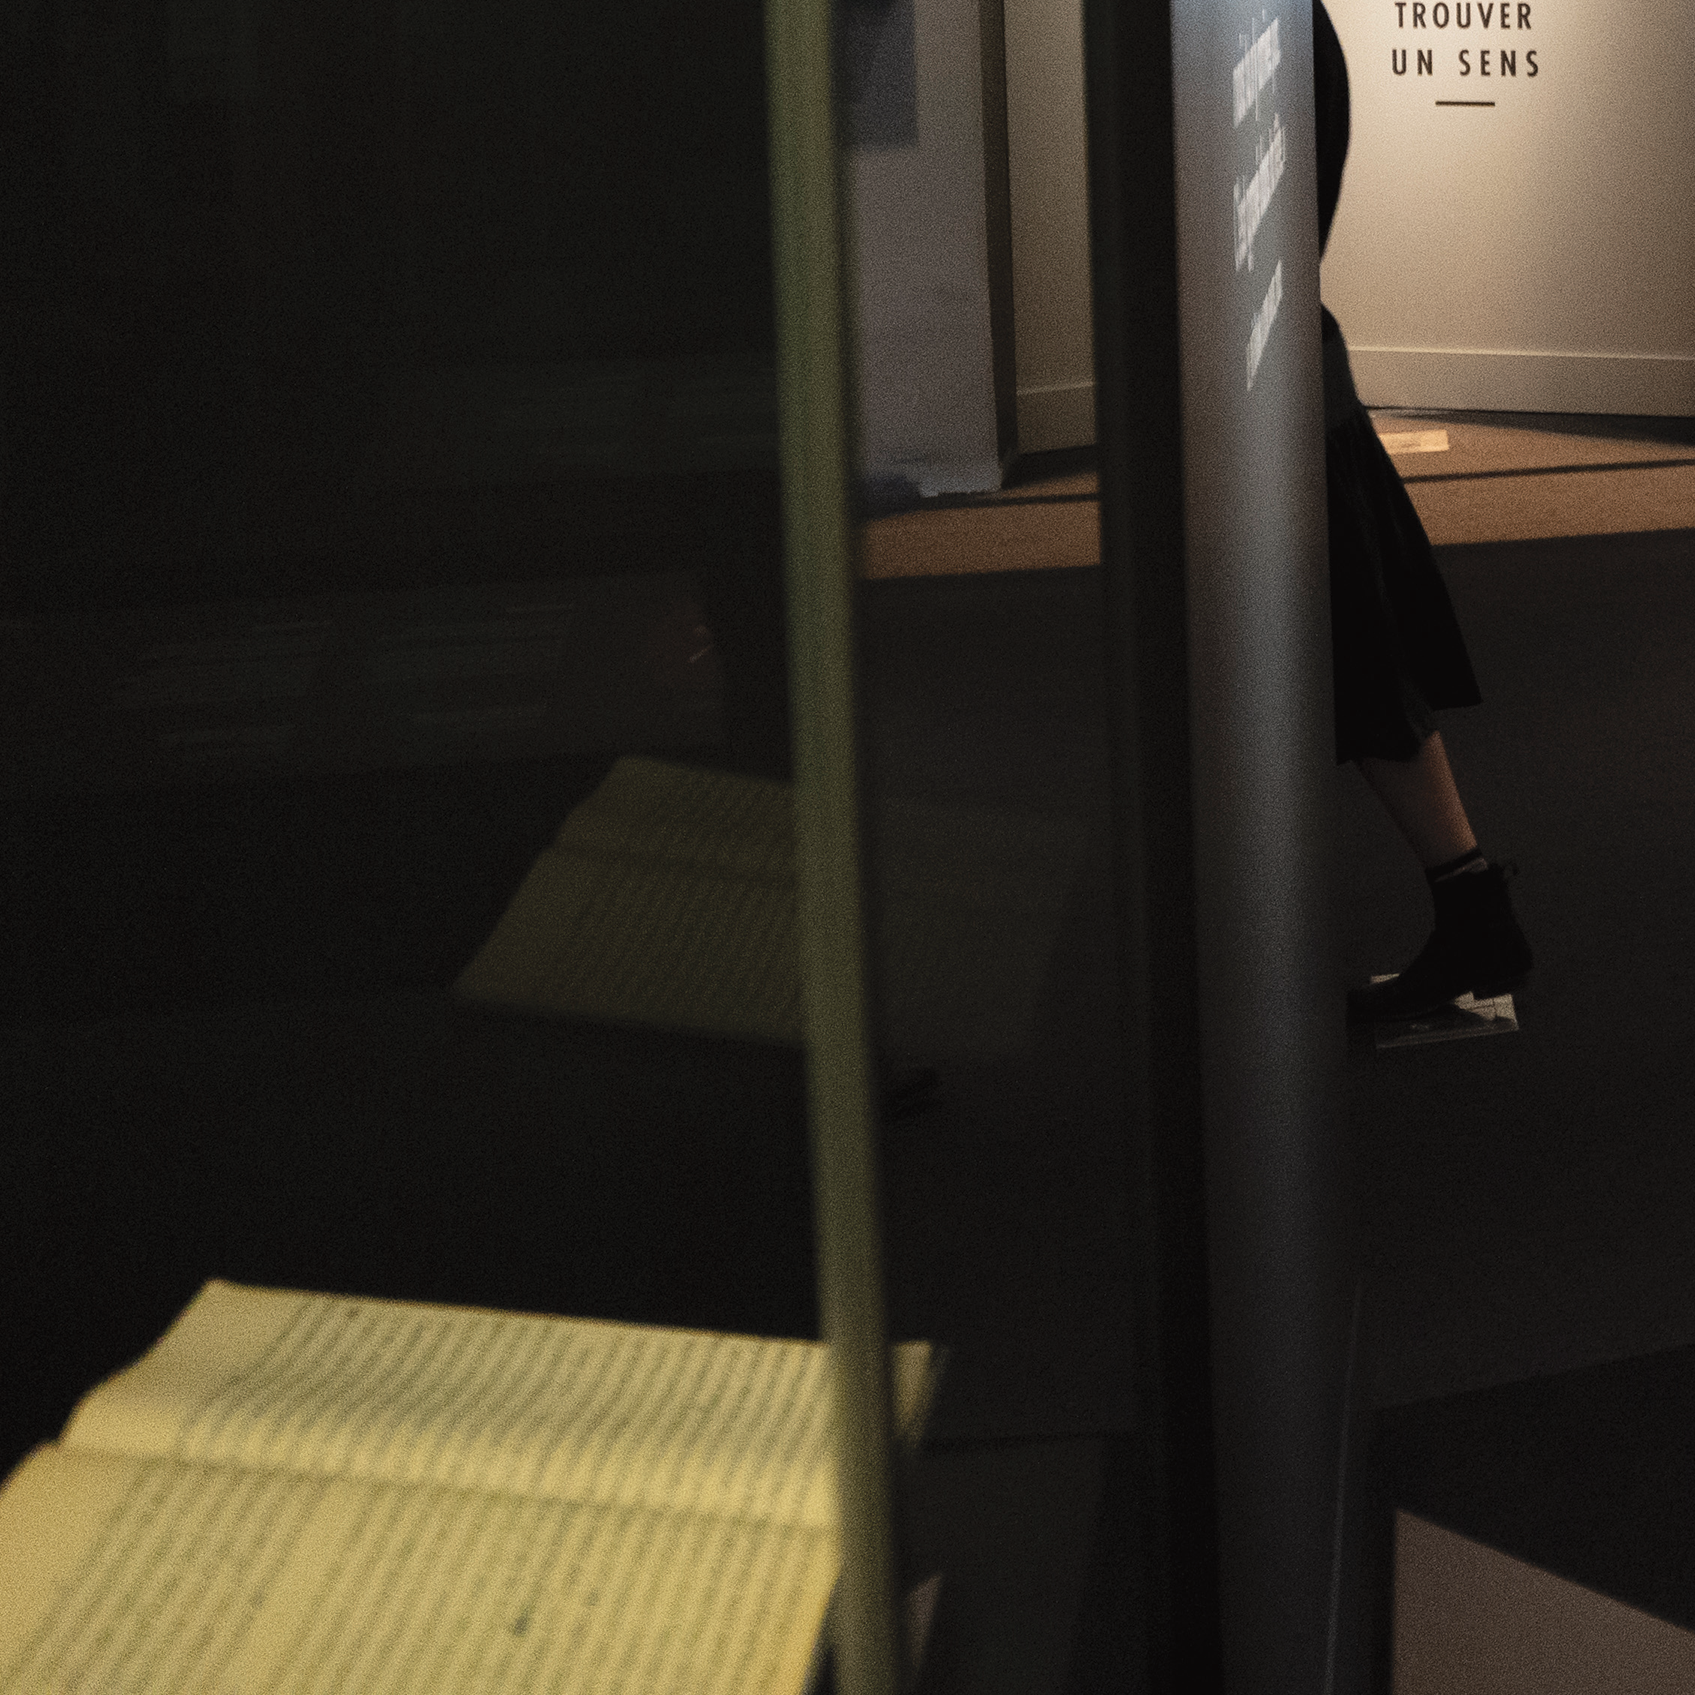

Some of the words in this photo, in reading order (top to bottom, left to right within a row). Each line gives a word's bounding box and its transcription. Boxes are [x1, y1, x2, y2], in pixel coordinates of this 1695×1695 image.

[1395, 1, 1532, 30] TROUVER
[1391, 49, 1434, 76] UN
[1459, 49, 1539, 77] SENS
